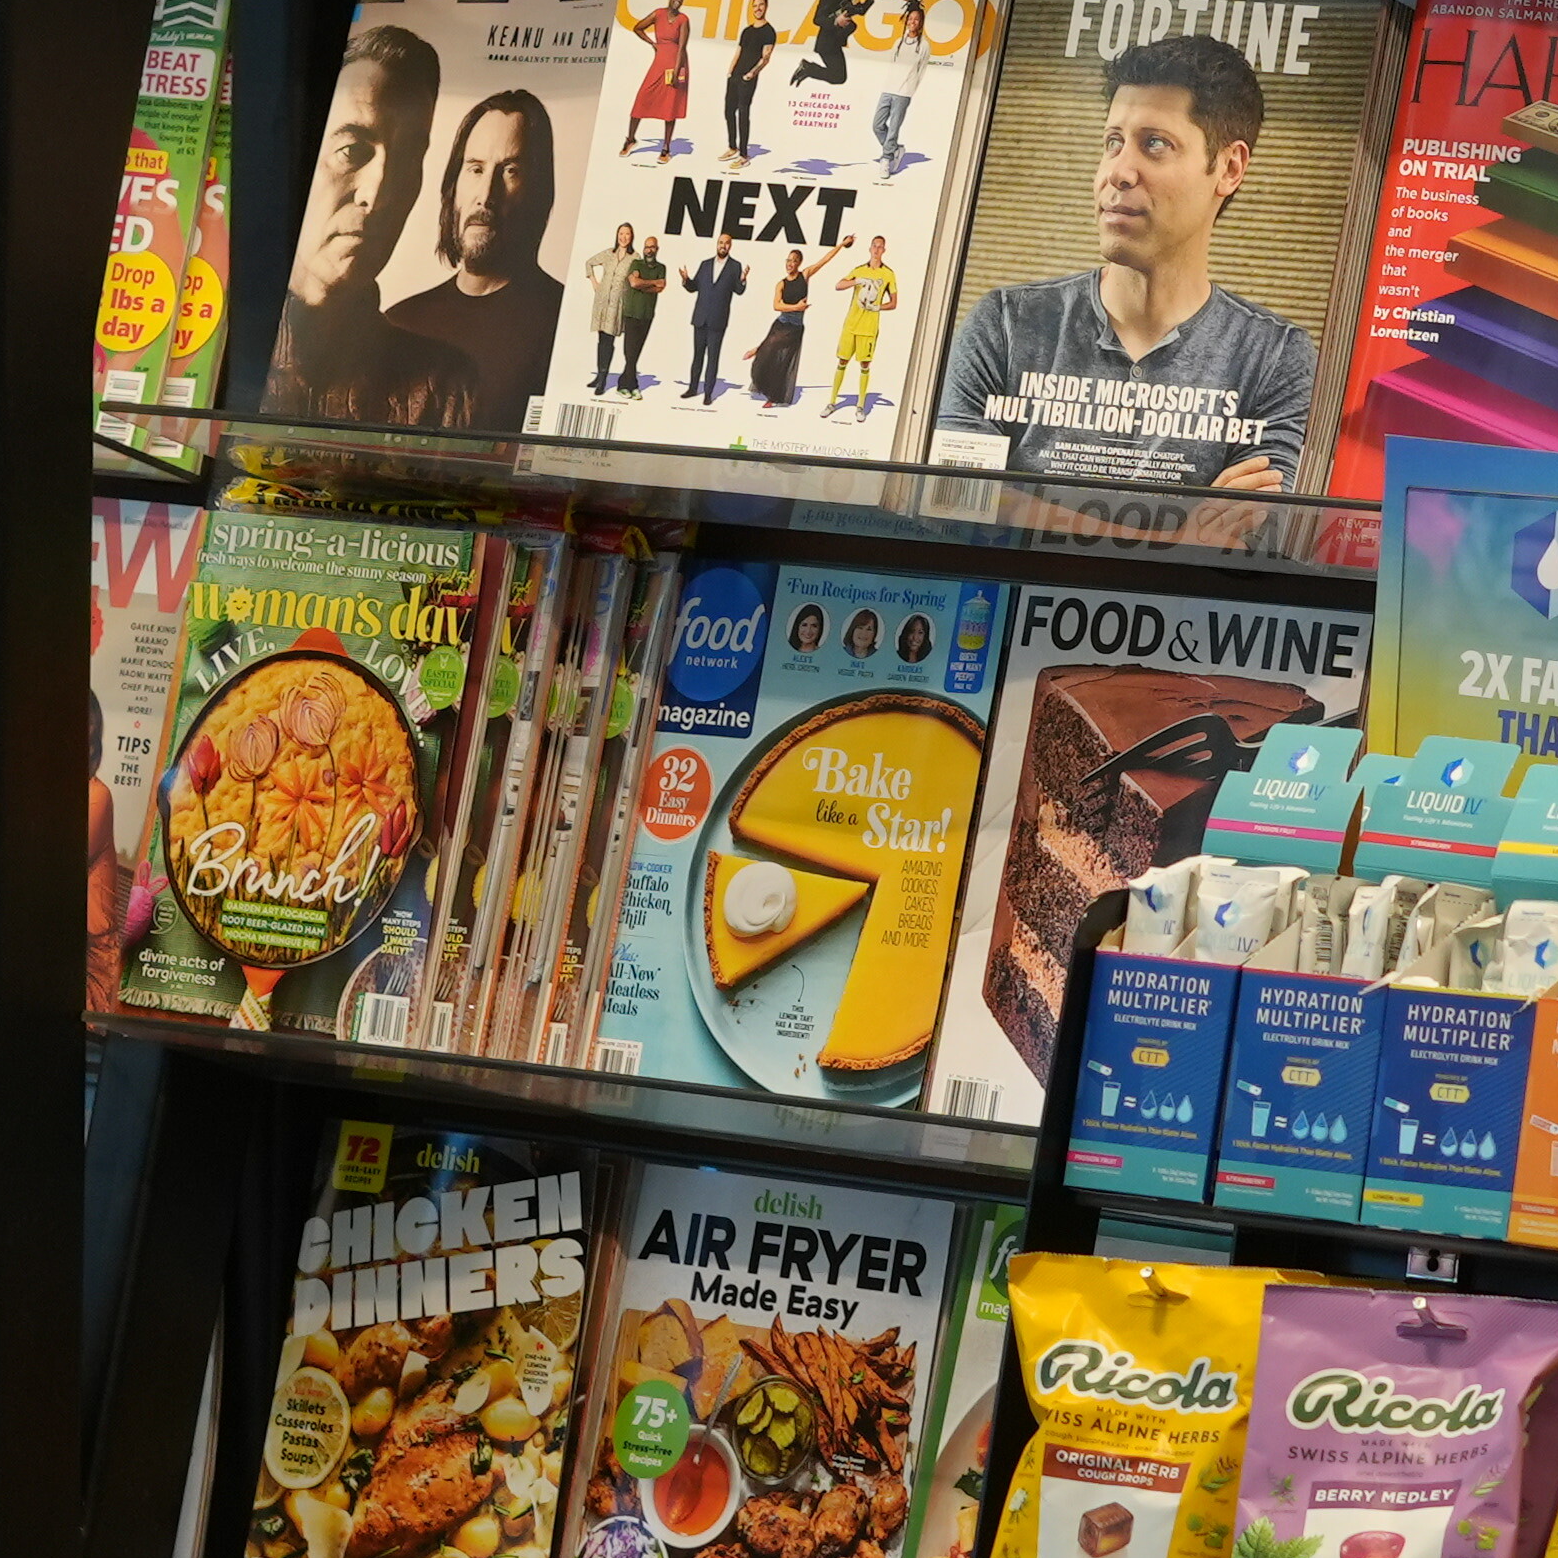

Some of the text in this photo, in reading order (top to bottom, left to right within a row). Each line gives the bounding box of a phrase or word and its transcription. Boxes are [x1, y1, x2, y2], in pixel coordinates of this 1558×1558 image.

[1398, 158, 1491, 183] ON TRIAL
[1401, 138, 1523, 164] PUBLISHING
[663, 175, 857, 246] NEXT
[1395, 185, 1480, 207] The business
[1369, 323, 1439, 344] Lorentzen
[1372, 305, 1456, 325] by Christian
[1019, 372, 1240, 417] INSIDE MICROSOFT'S
[984, 396, 1268, 445] MULTIBILLION-DOLLAR BET
[1457, 651, 1512, 698] 2X
[660, 755, 695, 792] 32
[802, 746, 911, 799] Bake
[645, 807, 697, 830] Dinners
[658, 791, 691, 812] Easy
[862, 805, 953, 854] Star!
[186, 815, 383, 905] Brunch!
[1111, 970, 1210, 995] HYDRATION
[1107, 990, 1208, 1017] MULTIPLIER
[638, 1212, 927, 1298] AIR FRYER
[690, 1271, 859, 1327] Made Easy
[1038, 1340, 1238, 1413] Ricola
[1287, 1370, 1505, 1438] Ricola
[1314, 1485, 1455, 1506] BERRY MEDLEY
